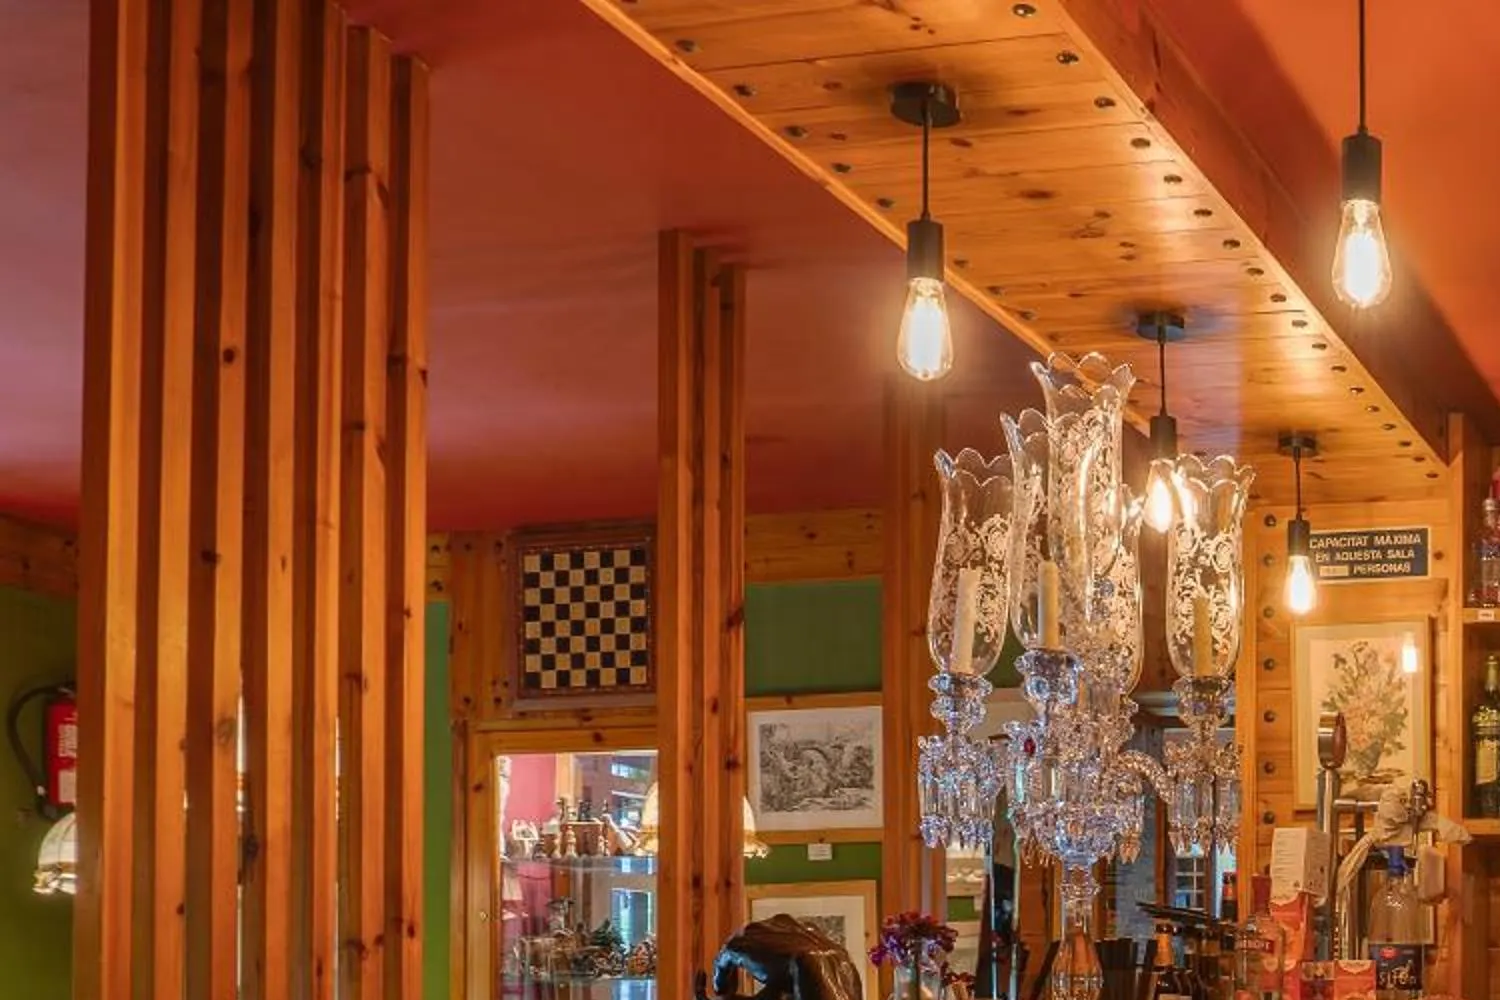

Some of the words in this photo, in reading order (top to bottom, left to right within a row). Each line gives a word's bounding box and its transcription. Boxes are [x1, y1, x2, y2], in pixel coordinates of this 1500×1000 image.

[1309, 536, 1369, 549] CAPACITAT
[1315, 552, 1330, 563] EN
[1335, 549, 1383, 561] AQUESTA
[1387, 548, 1416, 559] SALA
